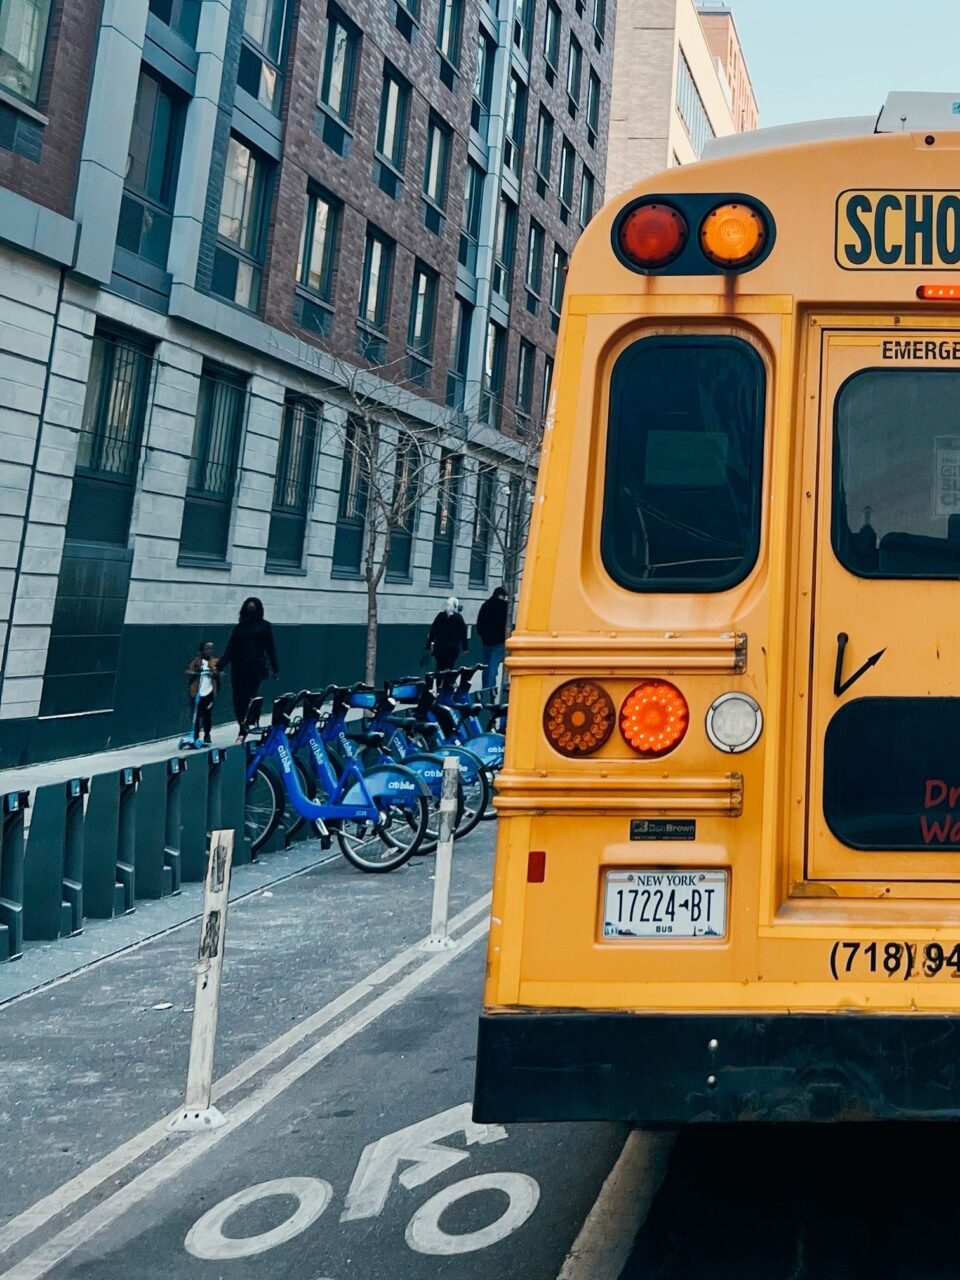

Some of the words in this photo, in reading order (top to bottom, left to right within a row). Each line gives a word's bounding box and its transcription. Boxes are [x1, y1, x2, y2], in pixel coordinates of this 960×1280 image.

[637, 875, 664, 887] NEW
[666, 875, 697, 887] YORK
[655, 925, 673, 933] BUS
[829, 941, 914, 981] (718)
